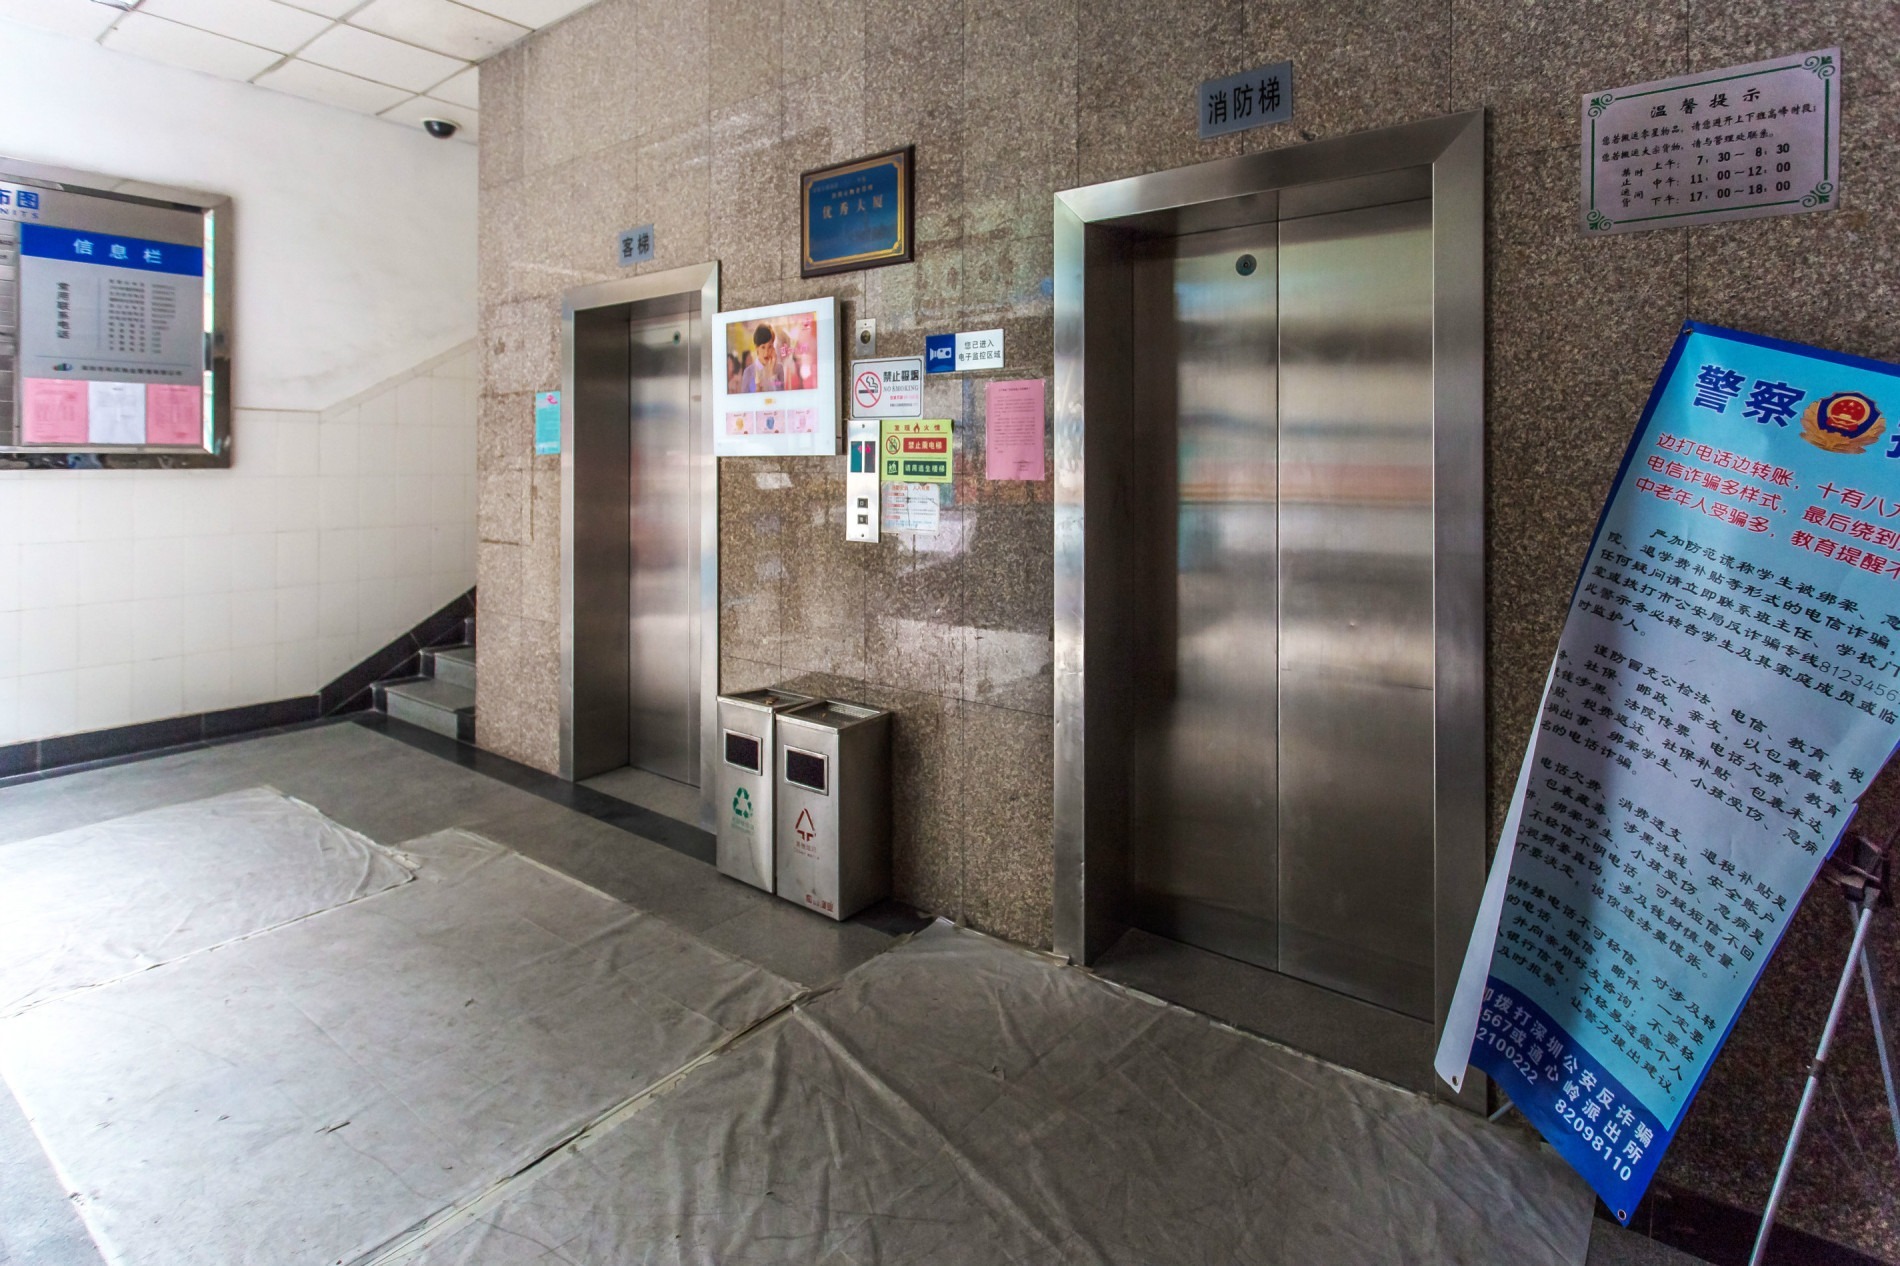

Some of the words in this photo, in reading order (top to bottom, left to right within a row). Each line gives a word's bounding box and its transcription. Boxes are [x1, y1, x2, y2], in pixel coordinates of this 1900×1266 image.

[1208, 76, 1280, 125] 消防梯
[1650, 87, 1761, 118] 温馨提示
[73, 238, 163, 265] 信息栏
[621, 232, 650, 258] 客梯
[958, 350, 1001, 362] 电子监控区域
[964, 339, 995, 350] 您已进入
[1692, 363, 1808, 429] 警察
[908, 441, 943, 450] 禁止乘电梯
[1646, 454, 1900, 551] 电信诈骗多样式，最后绕到
[1591, 565, 1900, 704] 室或拨打市公安局反诈骗专线8123456
[1543, 702, 1819, 856] 祸出事、绑架学生、小孩受伤、急病
[1550, 685, 1825, 841] 贴、税费返还、社保补贴、包裹未达、
[1554, 1098, 1633, 1182] 82098110
